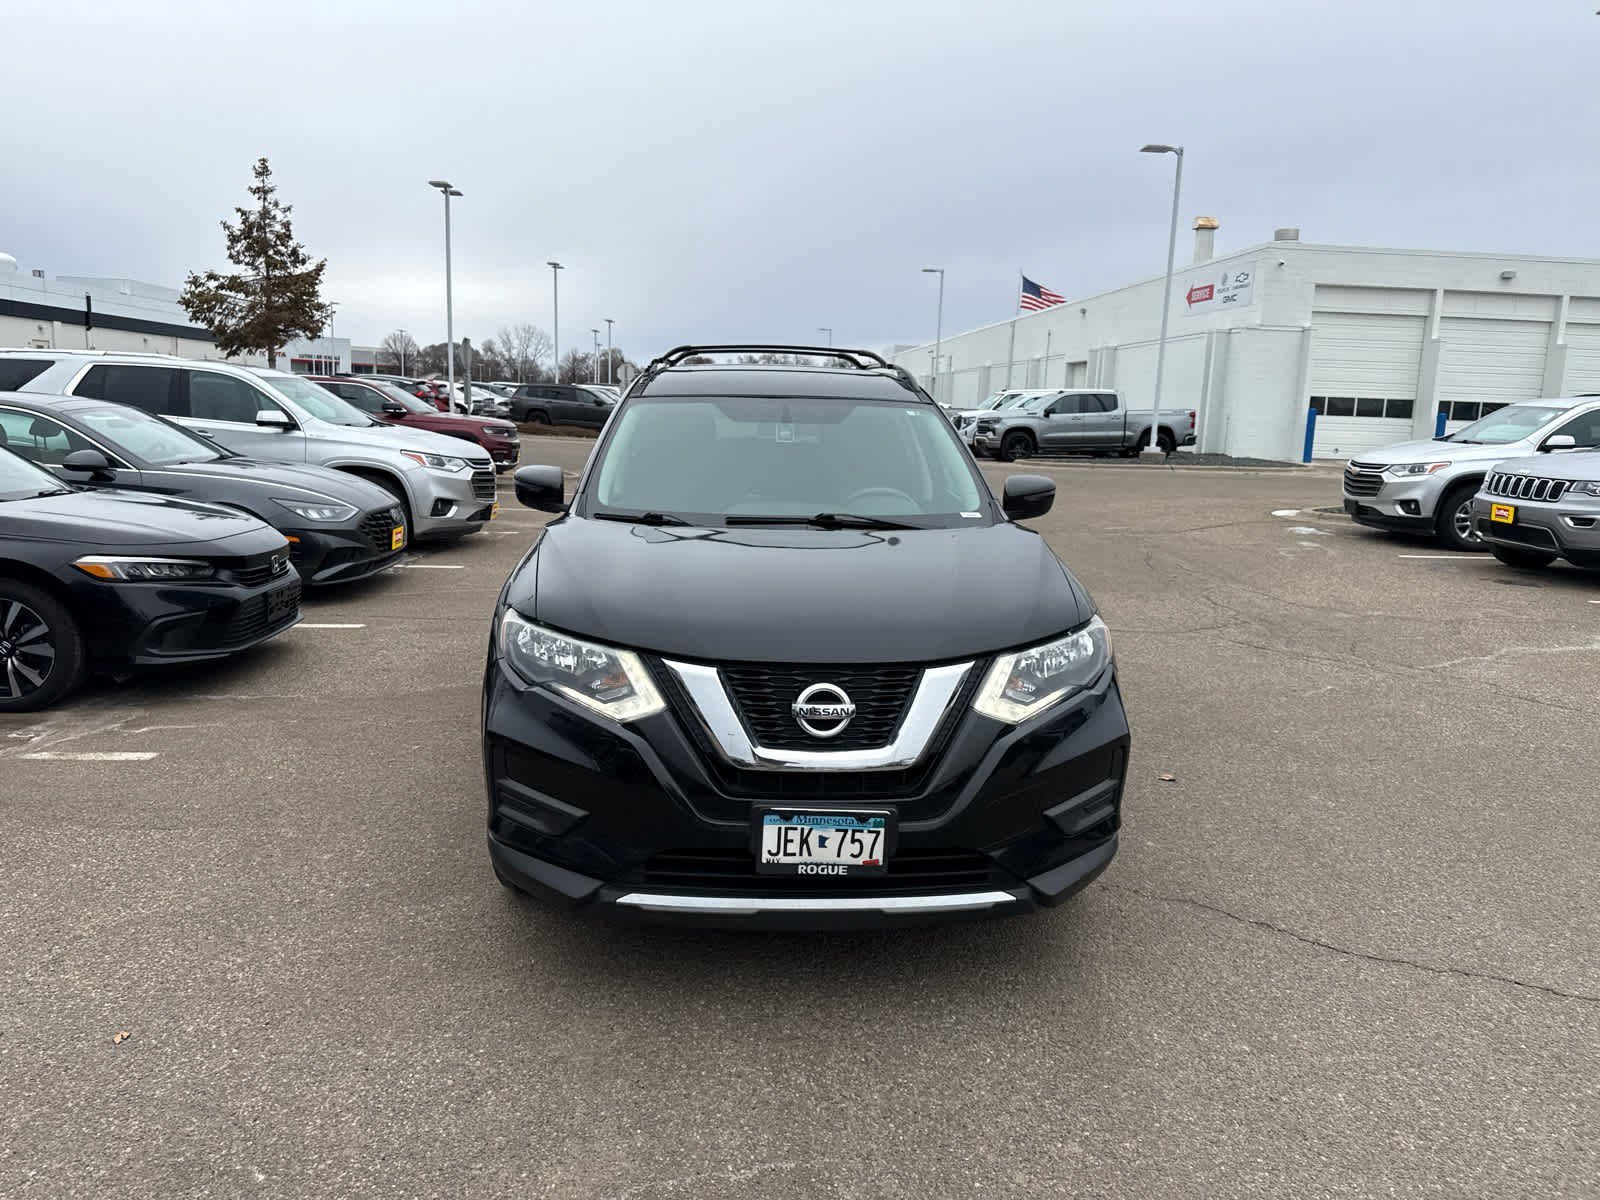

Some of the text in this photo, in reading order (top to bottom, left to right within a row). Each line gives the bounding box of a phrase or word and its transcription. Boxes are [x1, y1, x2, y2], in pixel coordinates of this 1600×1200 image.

[1191, 288, 1210, 301] SERVICE
[1223, 294, 1237, 303] GMC
[798, 706, 850, 716] NISSAN
[796, 815, 854, 826] Minnesota
[767, 827, 881, 860] JEK 757
[798, 864, 849, 875] ROGUE
